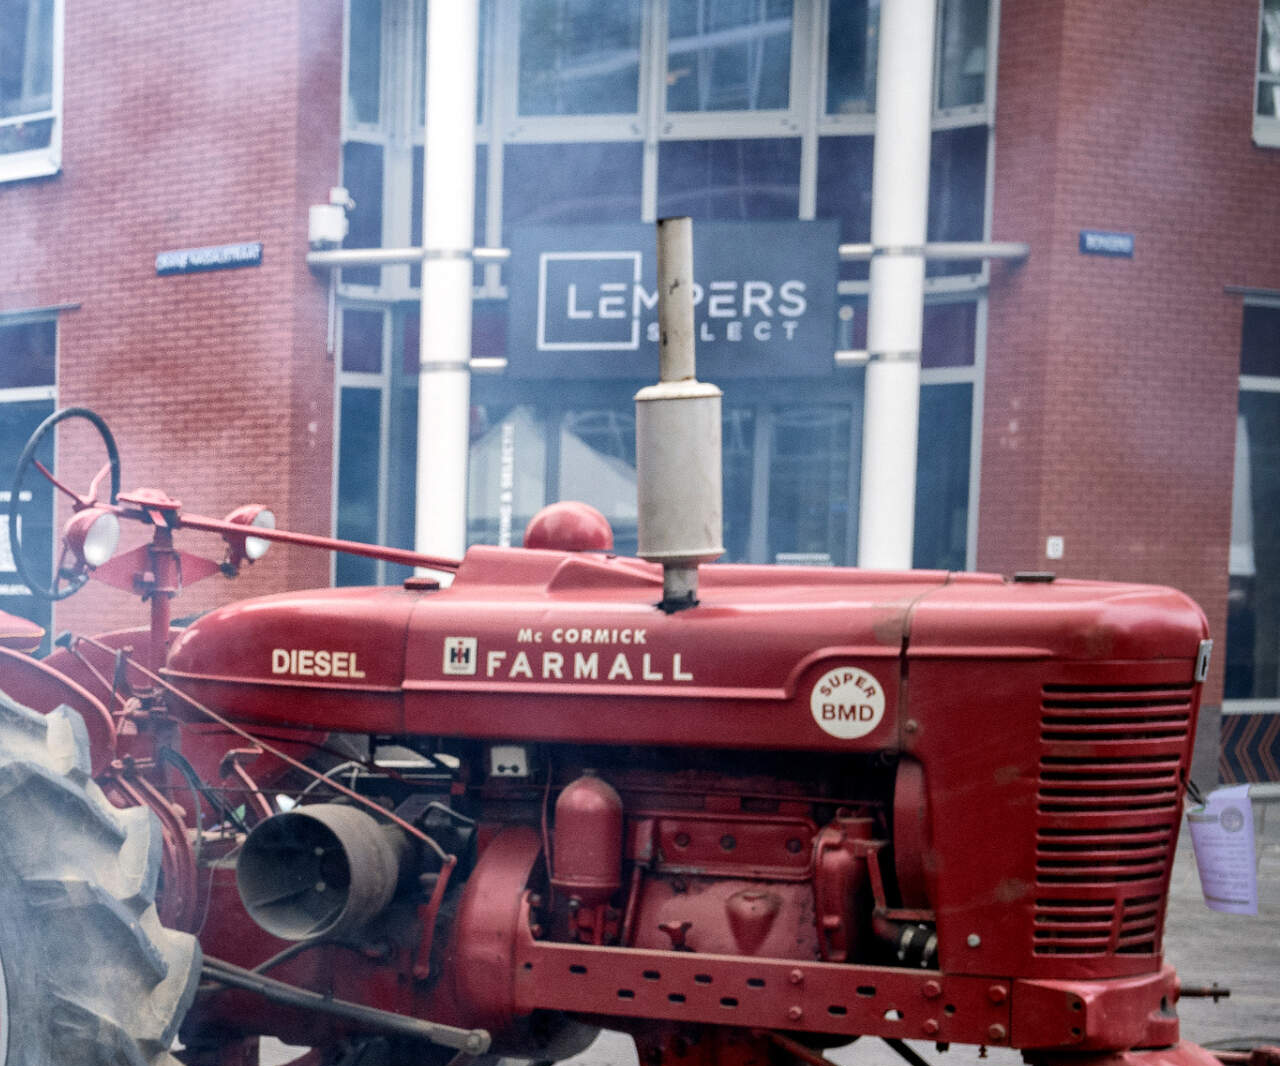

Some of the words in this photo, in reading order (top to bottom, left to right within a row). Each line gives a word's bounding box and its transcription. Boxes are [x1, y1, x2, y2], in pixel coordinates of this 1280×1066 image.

[646, 321, 798, 342] SLECT
[517, 628, 543, 644] Mc
[552, 628, 648, 644] CORMICK
[272, 648, 366, 679] DIESEL
[486, 651, 693, 681] FARMALL
[820, 672, 877, 699] SUPER
[822, 704, 874, 721] BMD
